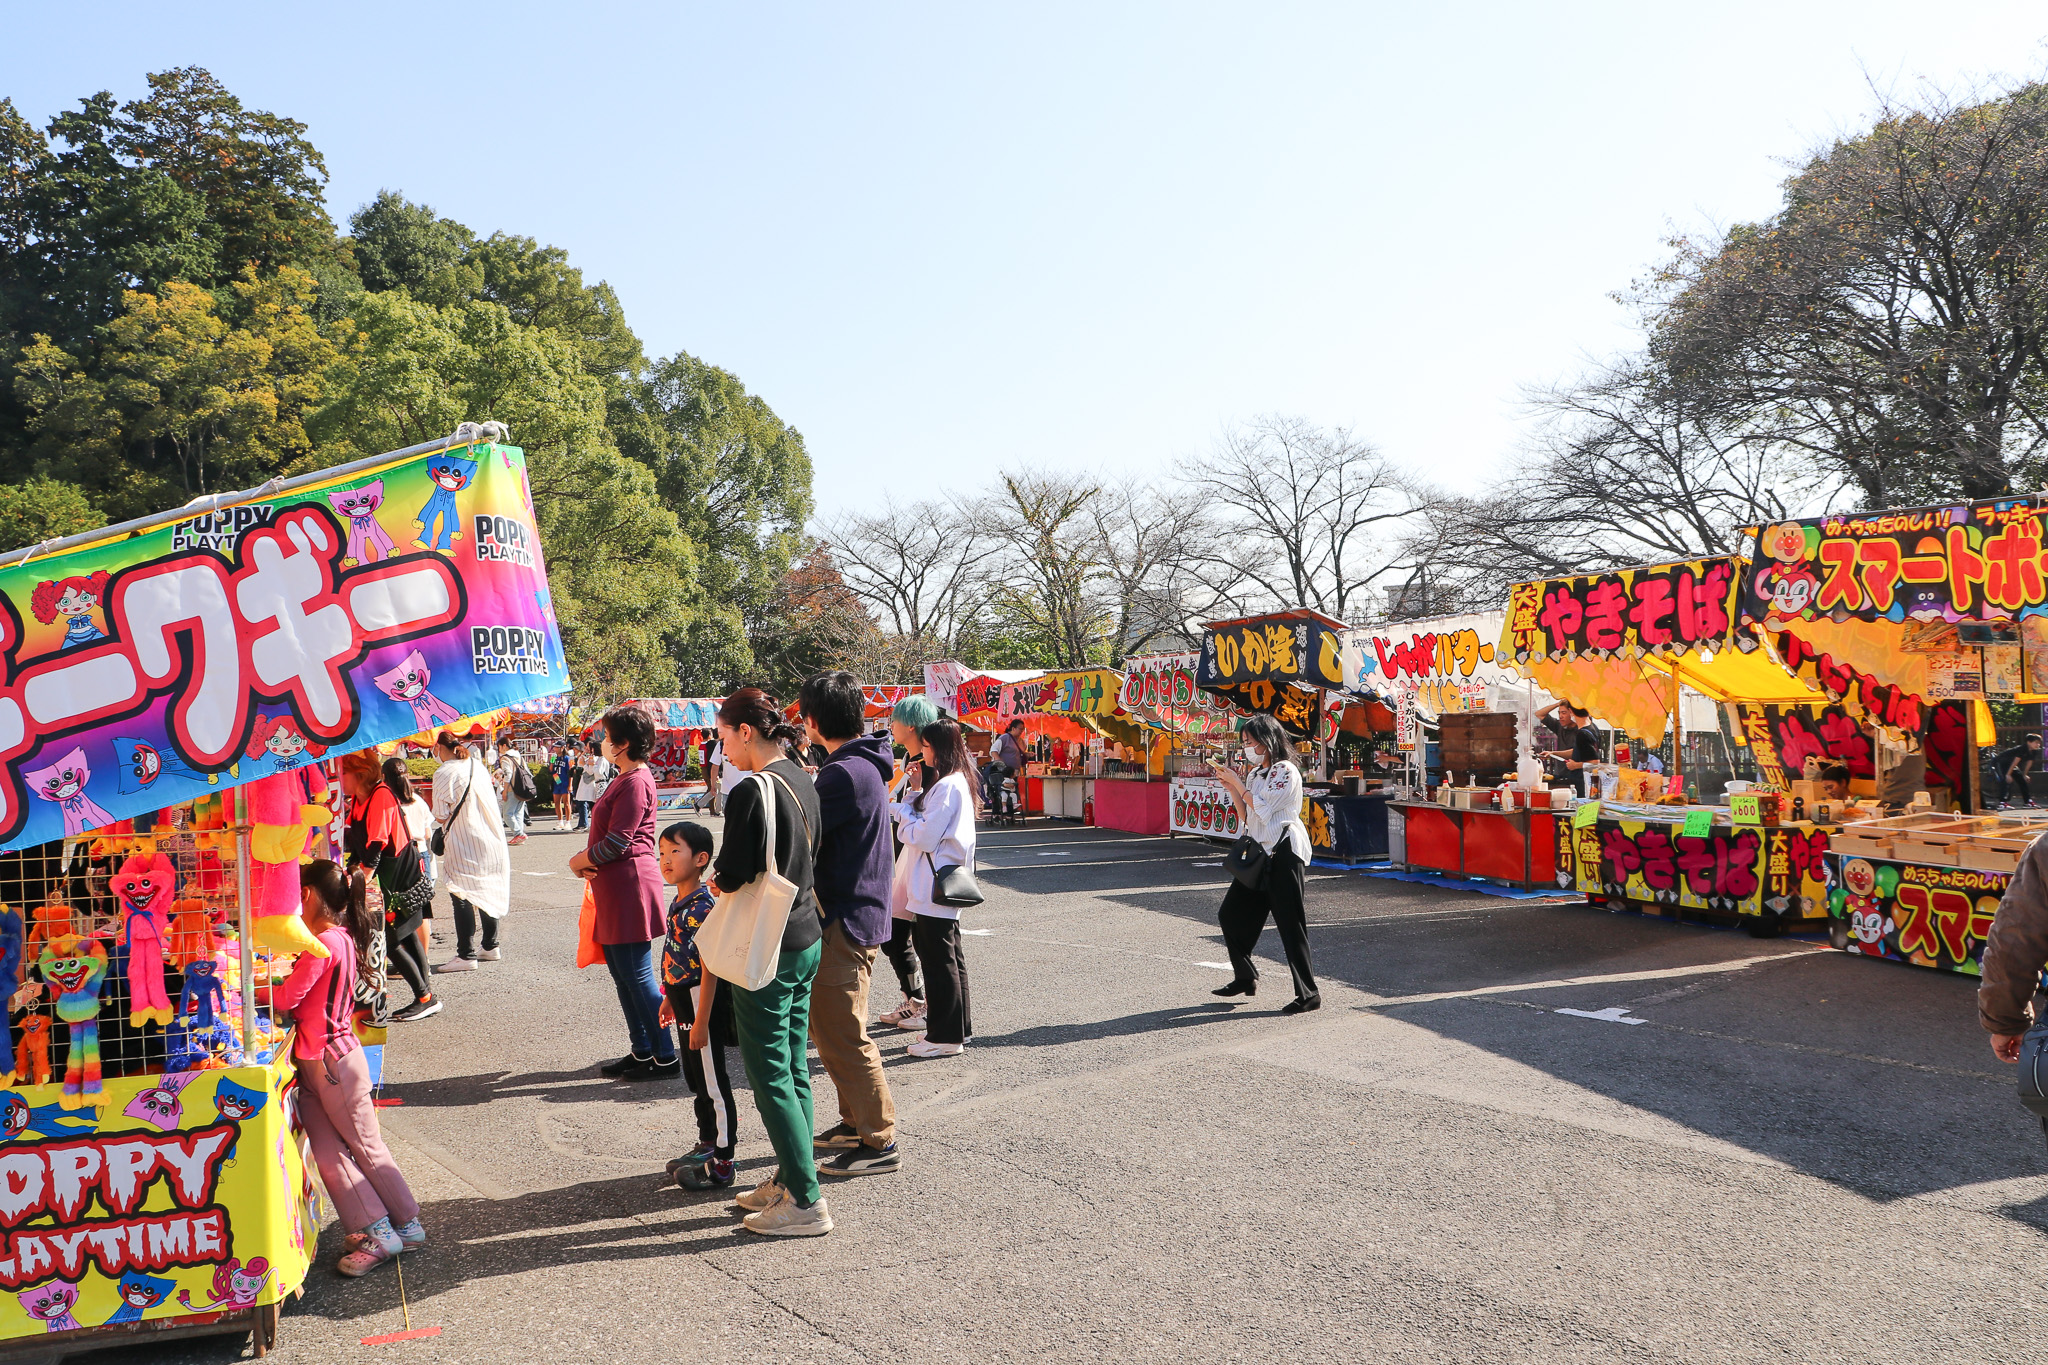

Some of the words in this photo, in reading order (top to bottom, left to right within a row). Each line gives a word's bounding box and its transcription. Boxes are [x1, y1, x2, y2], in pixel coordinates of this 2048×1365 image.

[1825, 510, 1952, 537] めっちゃたのしい!
[1816, 516, 2048, 611] スマートボ
[1513, 586, 1537, 651] 大盛り
[1540, 570, 1729, 651] やきそば
[472, 628, 543, 659] POPPY
[475, 657, 548, 676] PLAYTIME
[1372, 628, 1495, 680] じゃがバター
[1559, 817, 1573, 873] 大盛り
[1603, 828, 1760, 897] やきそば
[1769, 830, 1790, 897] 大盛り
